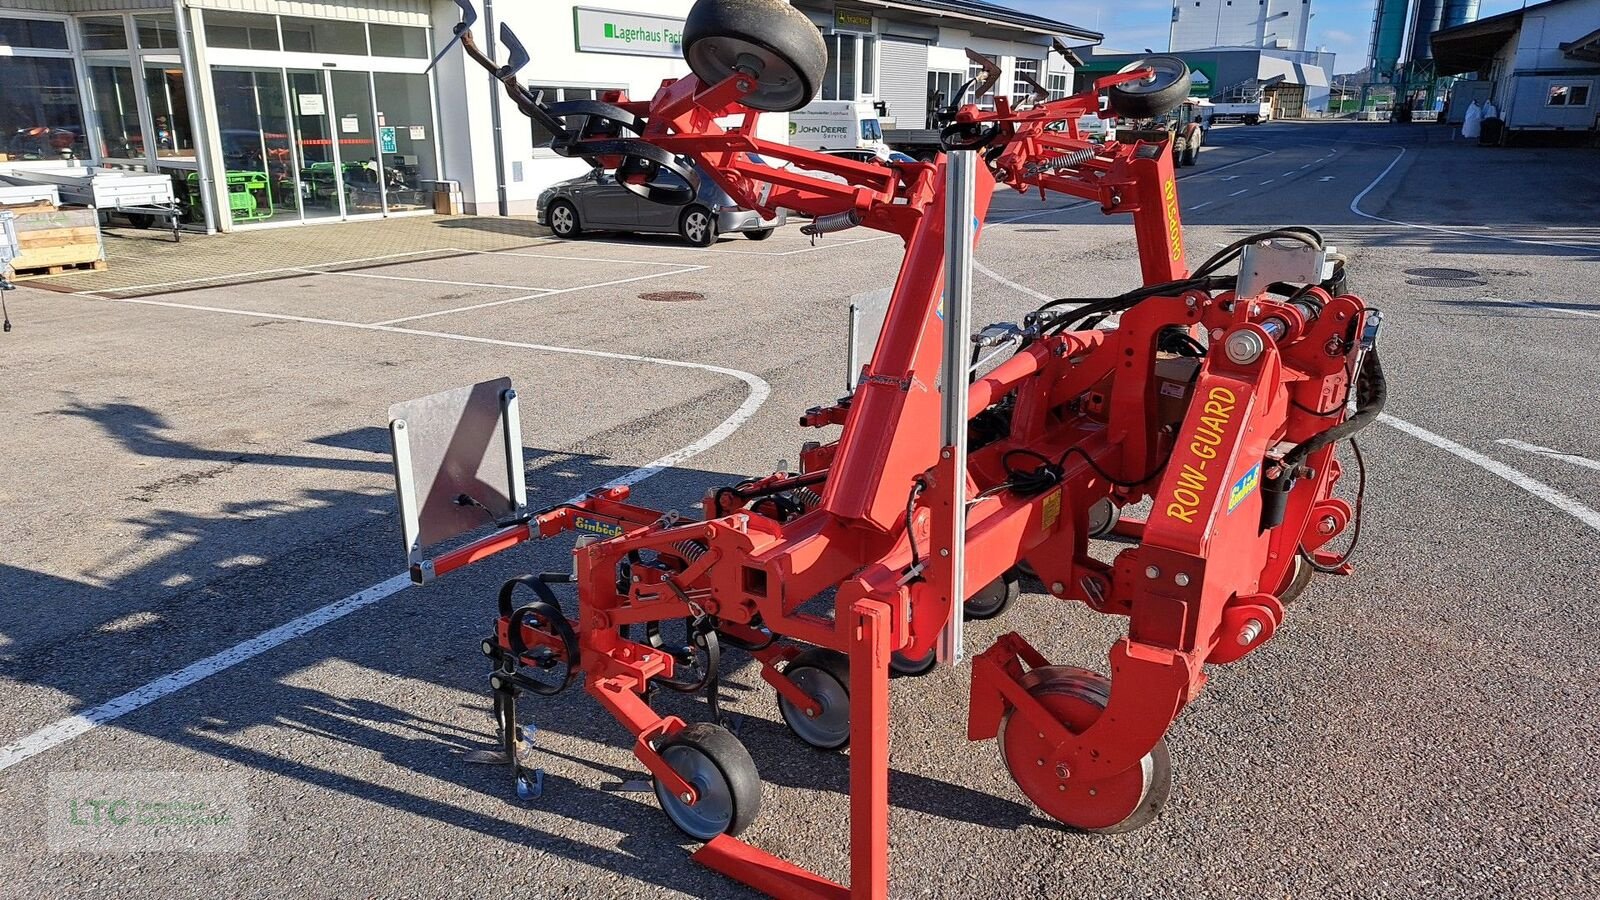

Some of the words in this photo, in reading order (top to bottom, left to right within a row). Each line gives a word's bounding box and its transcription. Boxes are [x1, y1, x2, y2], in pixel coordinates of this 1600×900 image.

[613, 24, 661, 43] Lagerhaus
[820, 125, 847, 133] DEERE
[1164, 174, 1181, 261] CHOPSTAR
[1166, 386, 1237, 524] ROW-GUARD
[575, 517, 622, 537] Einböck
